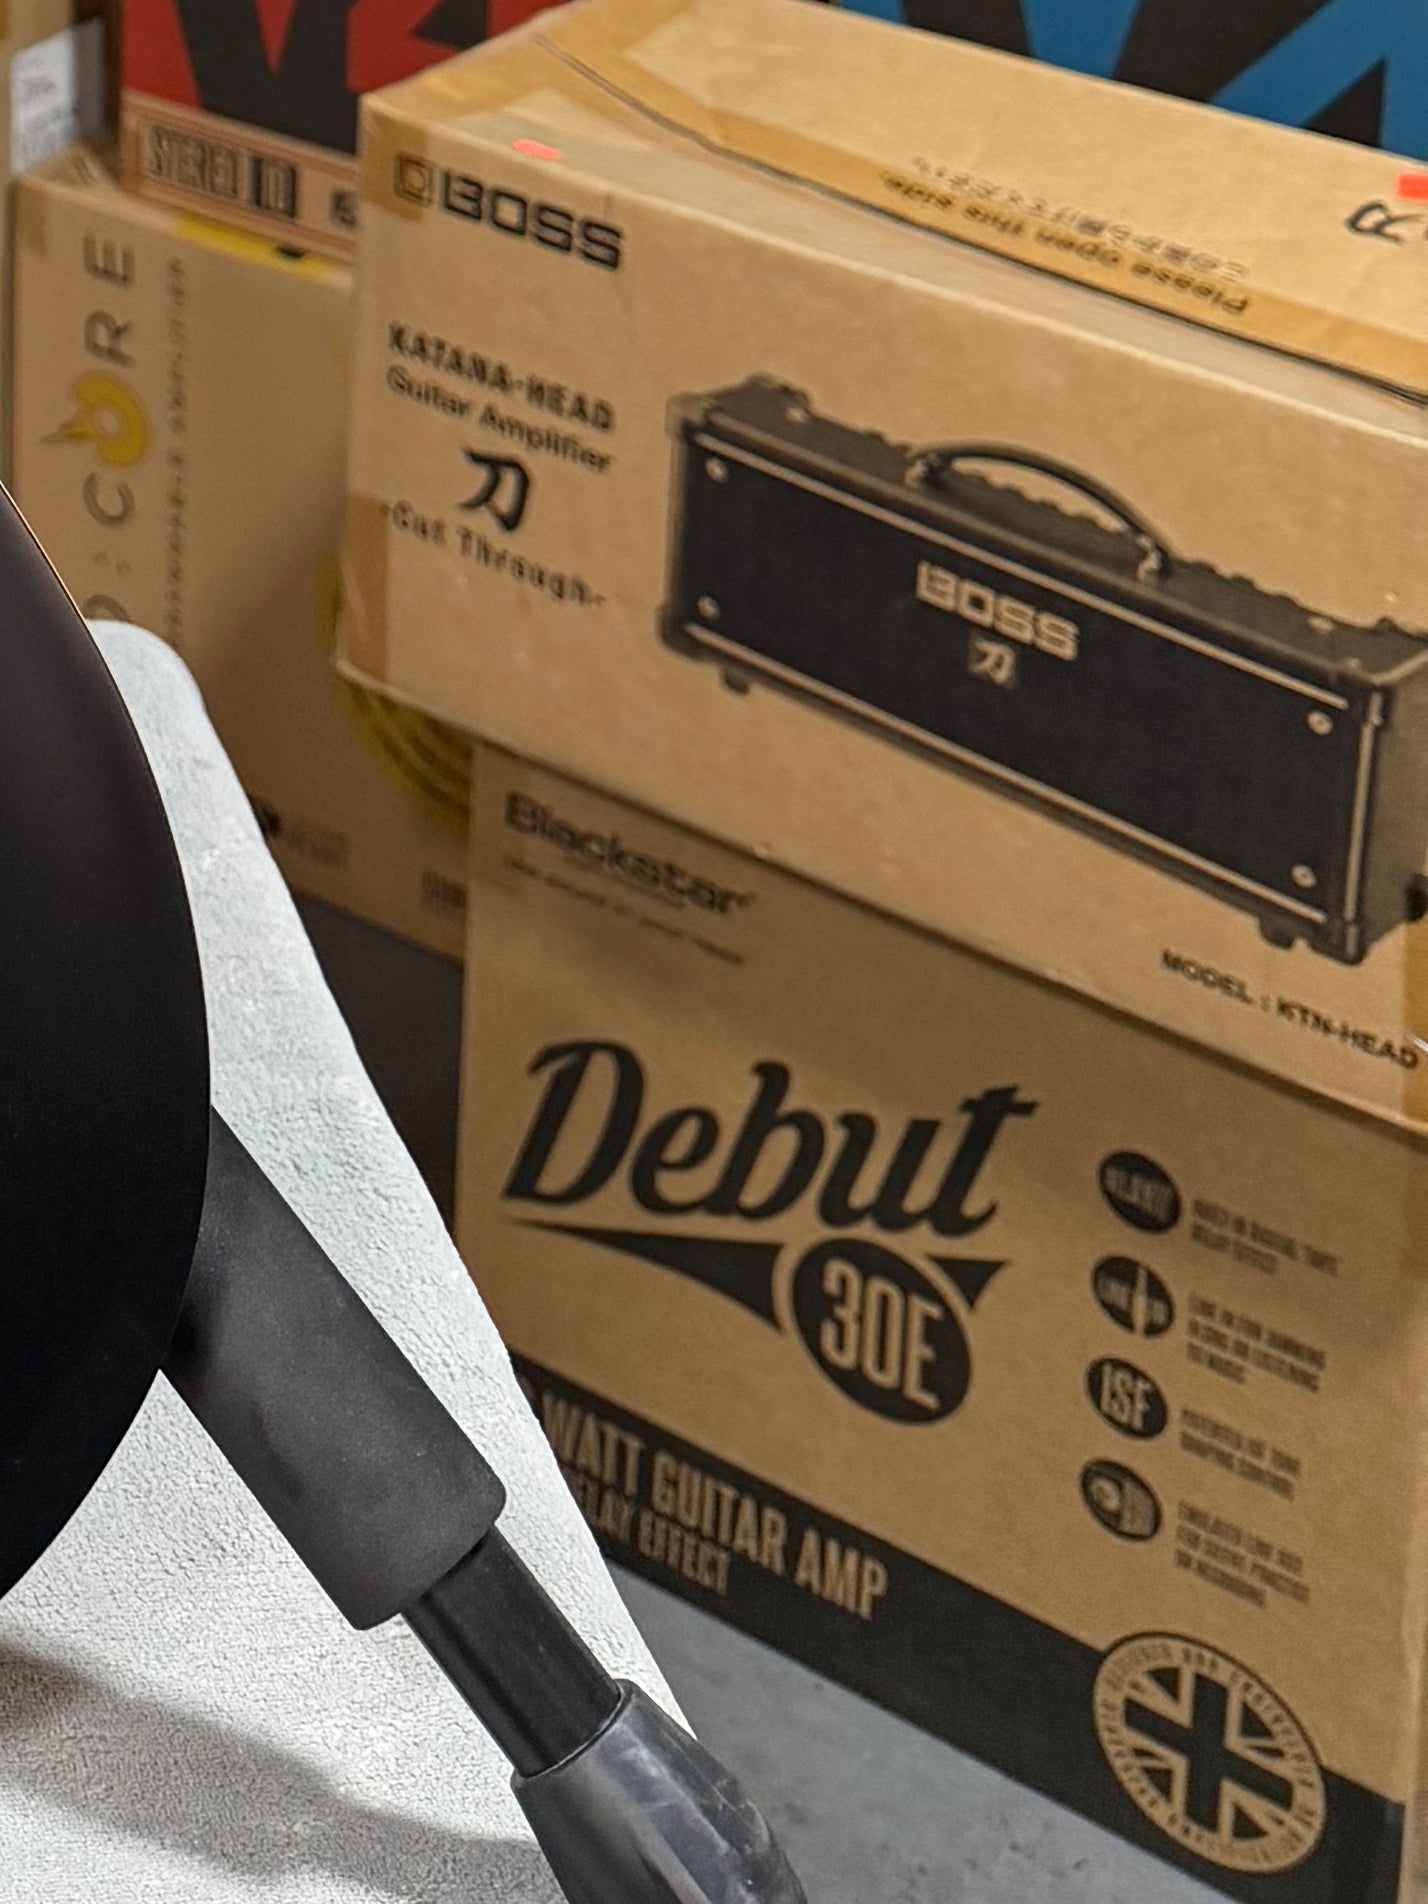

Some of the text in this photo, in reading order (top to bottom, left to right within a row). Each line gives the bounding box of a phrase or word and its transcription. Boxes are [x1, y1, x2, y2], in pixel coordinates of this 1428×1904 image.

[440, 169, 623, 271] BOSS
[962, 203, 1025, 246] this
[1038, 230, 1120, 268] open
[1131, 262, 1250, 314] Please
[386, 366, 611, 474] Guitar Amplifier
[388, 321, 614, 432] KATANA-HEAD
[916, 560, 1081, 662] BOSS
[503, 791, 755, 917] Blackstar
[1161, 947, 1253, 1006] MODEL
[1275, 998, 1421, 1073] KTN-HEAD
[502, 1038, 1039, 1241] Debut
[820, 1259, 943, 1413] 30E
[1100, 1363, 1152, 1431] ISF
[541, 1393, 889, 1622] WATT GUITAR AMP
[647, 1509, 732, 1599] EFFECT
